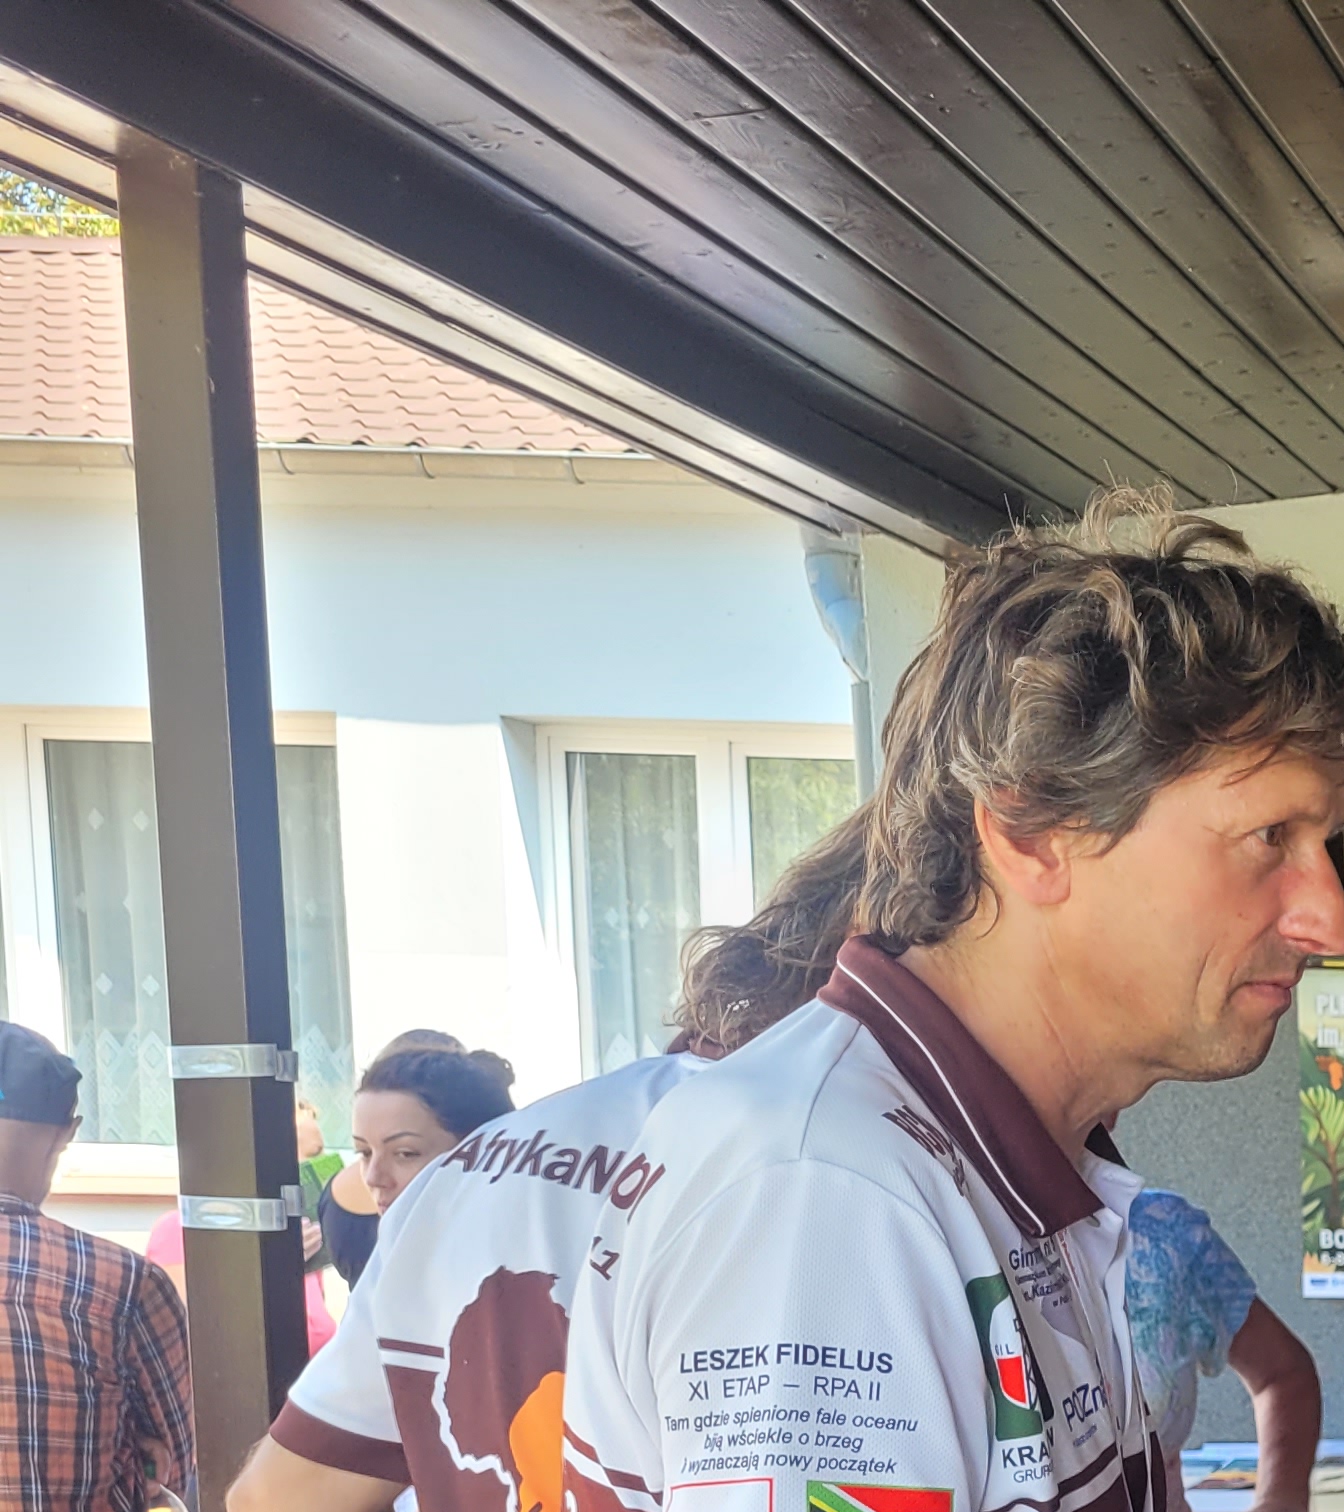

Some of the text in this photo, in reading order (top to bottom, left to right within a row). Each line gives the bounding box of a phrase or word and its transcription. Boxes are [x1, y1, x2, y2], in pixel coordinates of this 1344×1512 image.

[680, 1343, 893, 1374] LESZEK FIDELUS
[688, 1381, 710, 1401] XI
[722, 1374, 771, 1399] ETAP
[813, 1376, 862, 1400] RPA
[868, 1381, 881, 1402] II
[664, 1404, 919, 1433] Tam gdzie spienione fale oceanu
[726, 1427, 793, 1448] wściekle
[798, 1434, 810, 1446] o
[814, 1430, 864, 1454] brzeg
[763, 1453, 814, 1473] nowy
[816, 1456, 898, 1475] początek
